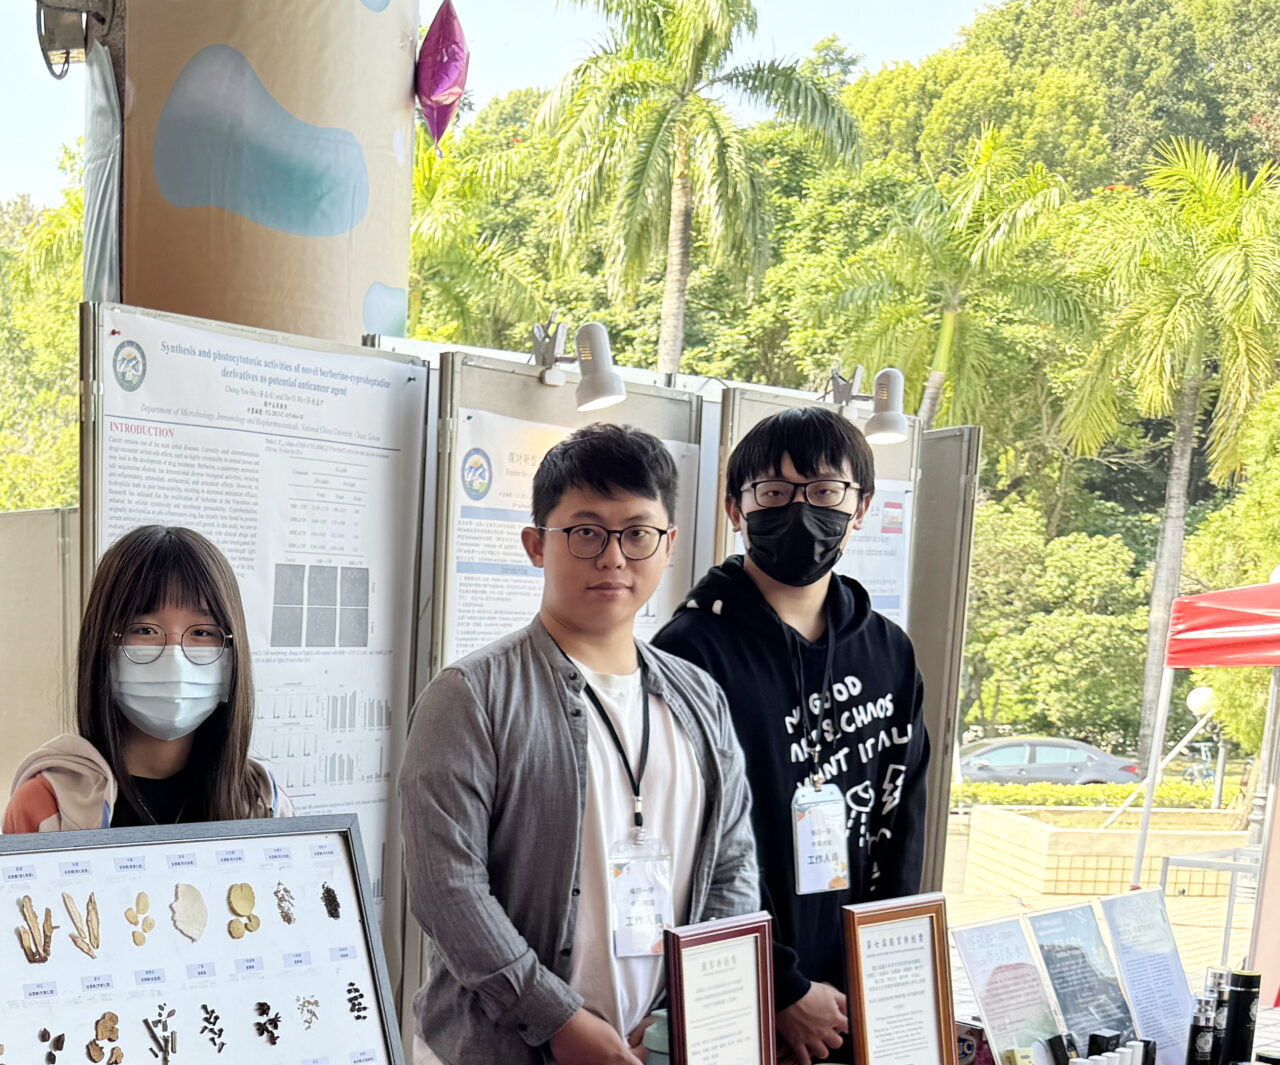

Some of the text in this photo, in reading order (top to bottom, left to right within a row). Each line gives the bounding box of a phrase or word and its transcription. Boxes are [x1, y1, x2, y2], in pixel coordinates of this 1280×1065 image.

[160, 340, 197, 356] Synthesis
[197, 348, 211, 359] and
[263, 358, 292, 372] activities
[293, 363, 301, 374] of
[301, 366, 319, 377] novel
[221, 366, 347, 396] derivatives as potential anticancer agent
[110, 421, 174, 438] INTRODUCTION
[840, 693, 894, 732] CHAOS
